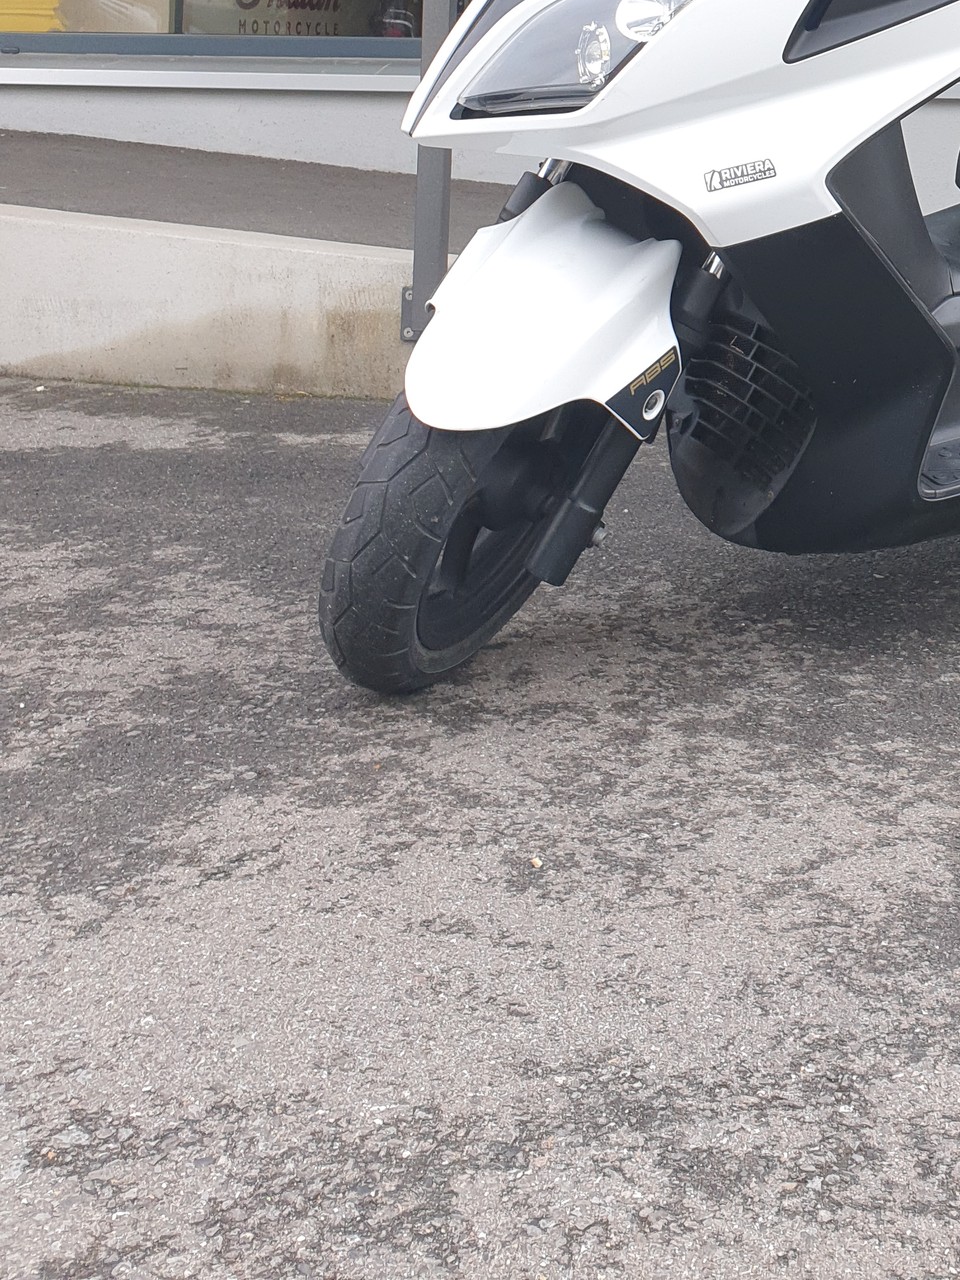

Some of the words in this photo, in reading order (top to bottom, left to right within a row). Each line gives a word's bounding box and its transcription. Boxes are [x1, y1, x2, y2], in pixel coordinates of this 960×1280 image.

[238, 19, 340, 36] MOTORCYCLE
[720, 159, 774, 181] RIVIERA
[723, 169, 776, 188] MOTORCYCLES
[629, 349, 676, 396] ABS
